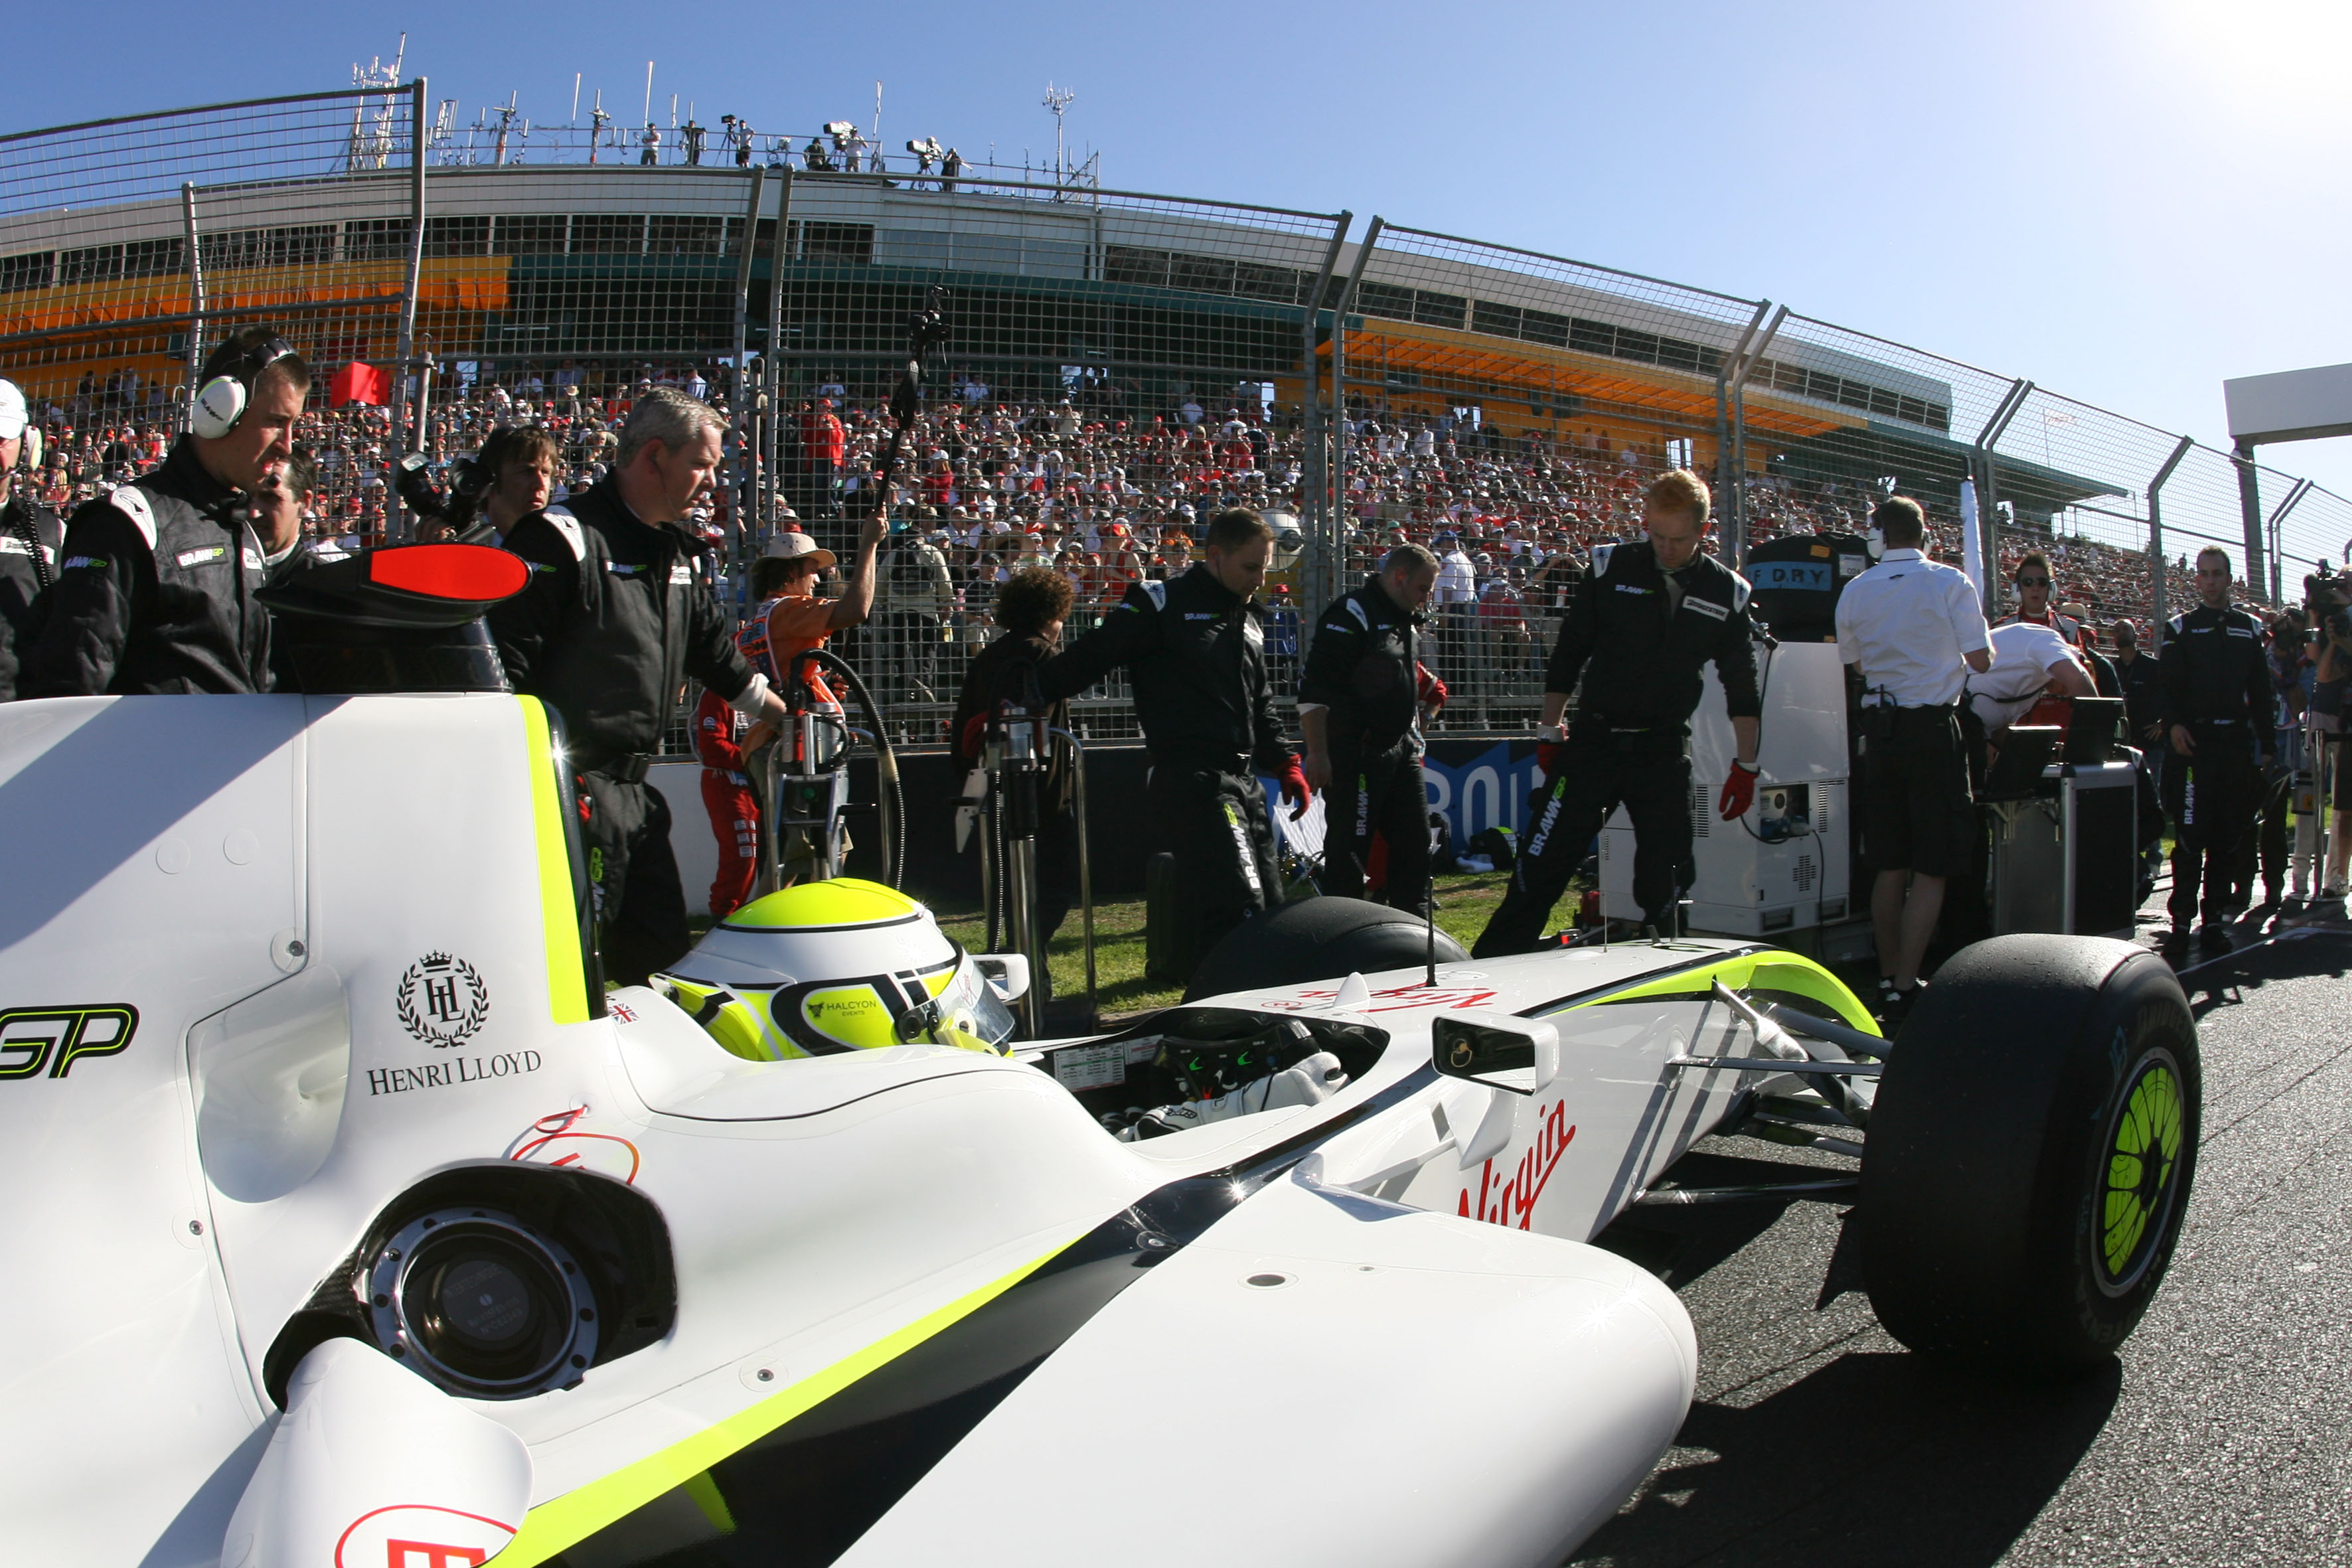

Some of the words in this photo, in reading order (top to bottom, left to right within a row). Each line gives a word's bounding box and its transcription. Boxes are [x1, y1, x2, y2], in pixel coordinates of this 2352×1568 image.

[826, 1000, 877, 1010] HALCYON
[0, 1002, 139, 1081] GP
[366, 1062, 453, 1096] HENRI
[455, 1049, 542, 1083] LLOYD
